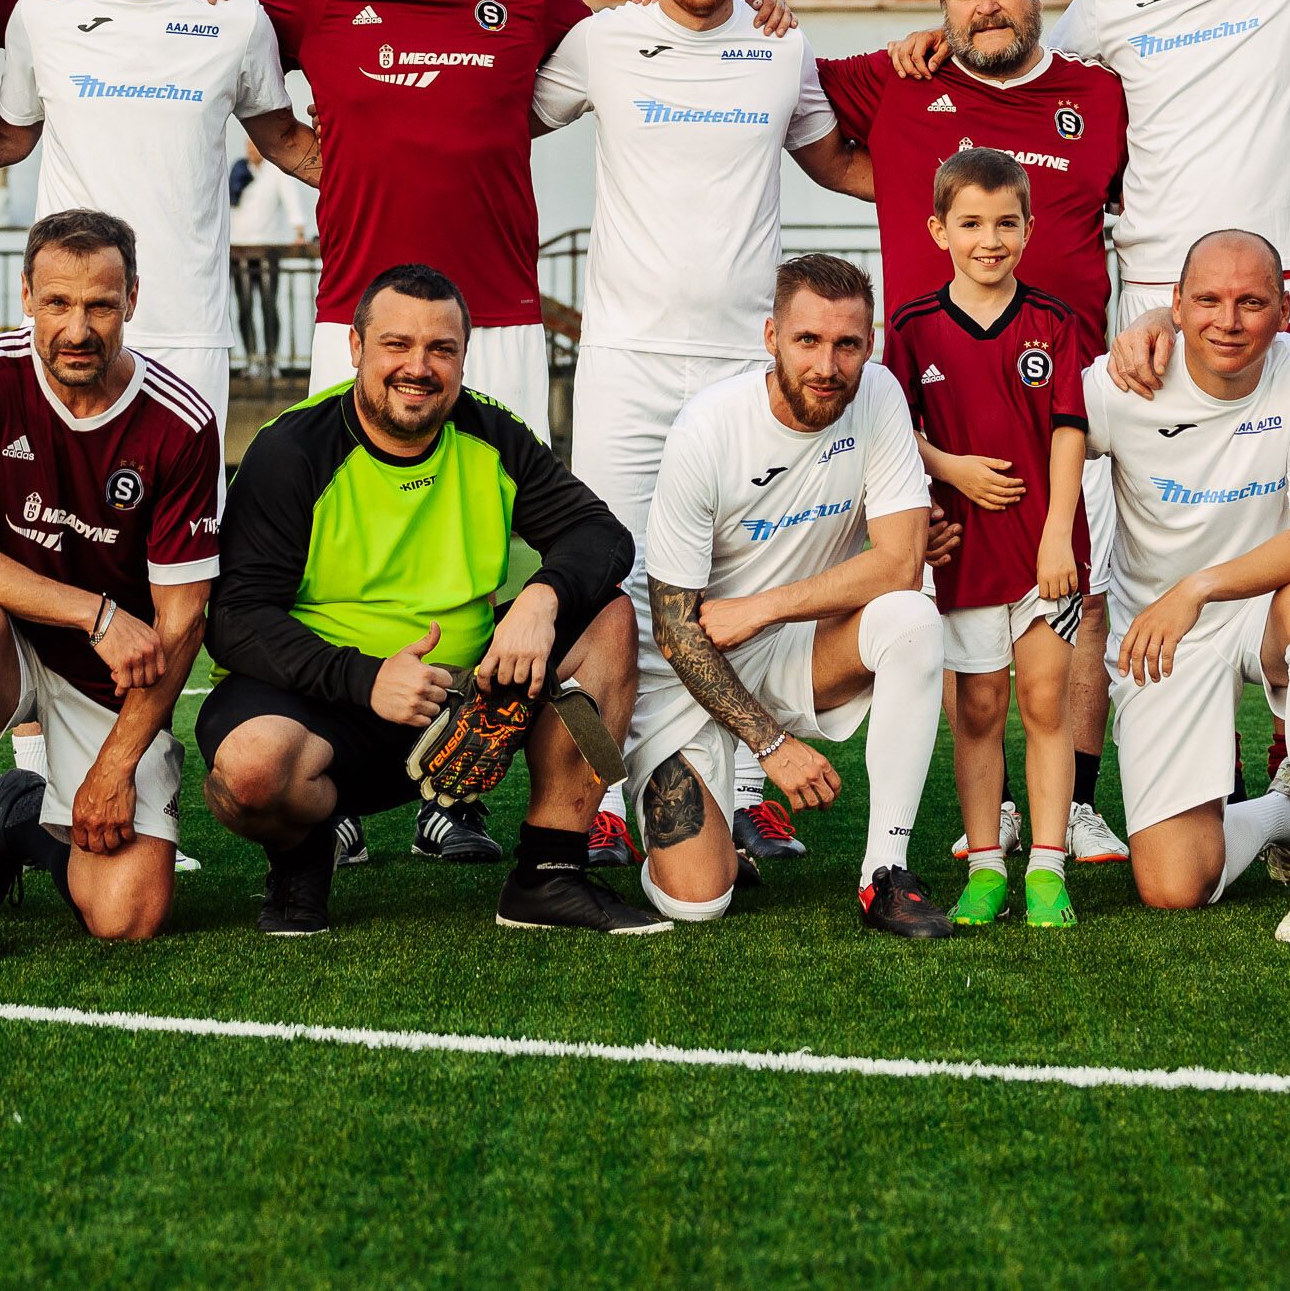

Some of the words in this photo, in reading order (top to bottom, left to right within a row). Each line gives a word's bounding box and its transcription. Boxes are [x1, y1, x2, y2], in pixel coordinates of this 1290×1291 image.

[352, 16, 383, 25] adidas
[166, 22, 189, 33] AAA
[191, 24, 220, 36] AUTO
[1127, 17, 1259, 58] Mototechna
[398, 52, 495, 68] MEGADYNE
[721, 49, 743, 58] AAA
[746, 49, 773, 59] AUTO
[69, 75, 203, 102] Mototechna
[633, 100, 769, 124] Mototechna
[921, 374, 946, 385] adidas
[1, 447, 35, 461] adidas
[400, 475, 437, 491] KIPST
[429, 717, 469, 772] reusch
